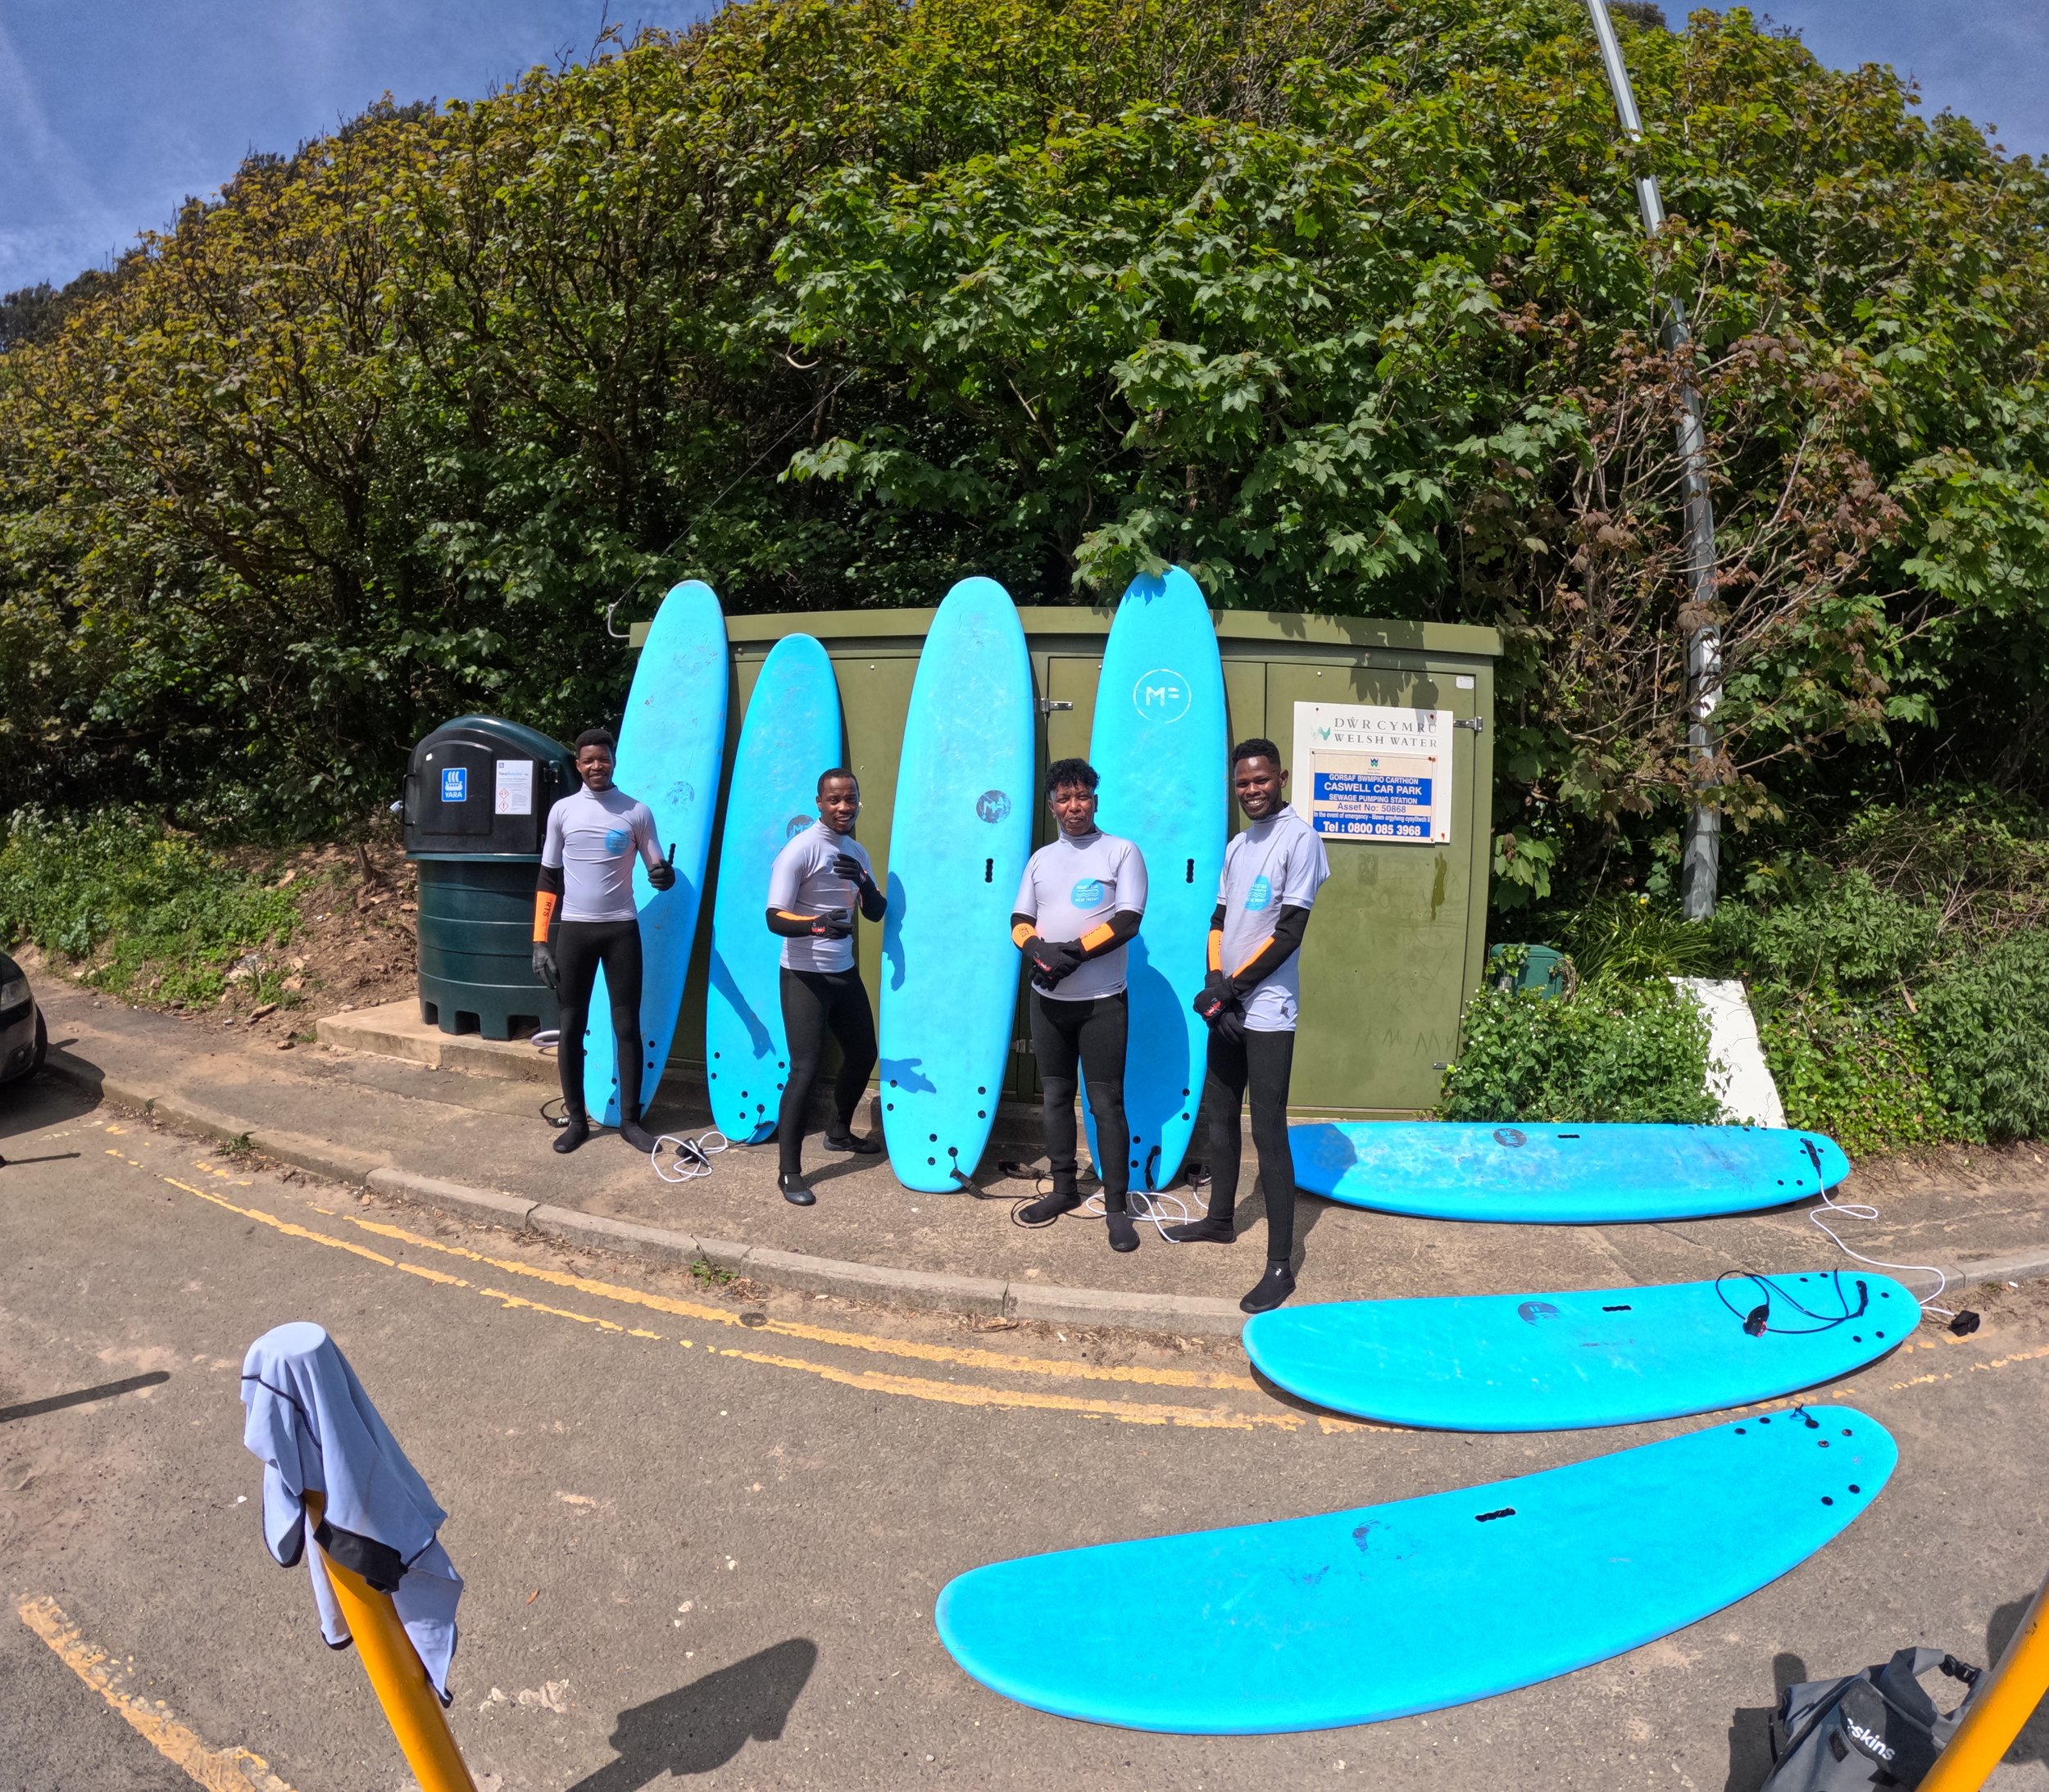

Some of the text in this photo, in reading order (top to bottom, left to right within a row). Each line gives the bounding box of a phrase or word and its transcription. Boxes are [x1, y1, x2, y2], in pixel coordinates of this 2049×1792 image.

[1377, 720, 1437, 733] CYMRU
[1334, 733, 1437, 747] WELSH WATER
[1329, 774, 1419, 785] GORSAF BWMPIO CARTHION
[444, 791, 463, 799] YARA
[1324, 783, 1422, 796] CASWELL CAR PARK
[1329, 793, 1418, 805] SEWAGE PUMPING STATION
[1337, 802, 1406, 814] Asset No: 50868
[1323, 820, 1338, 832] Tel
[1347, 822, 1373, 833] 0800
[1375, 823, 1394, 834] 085
[1396, 824, 1421, 836] 3968
